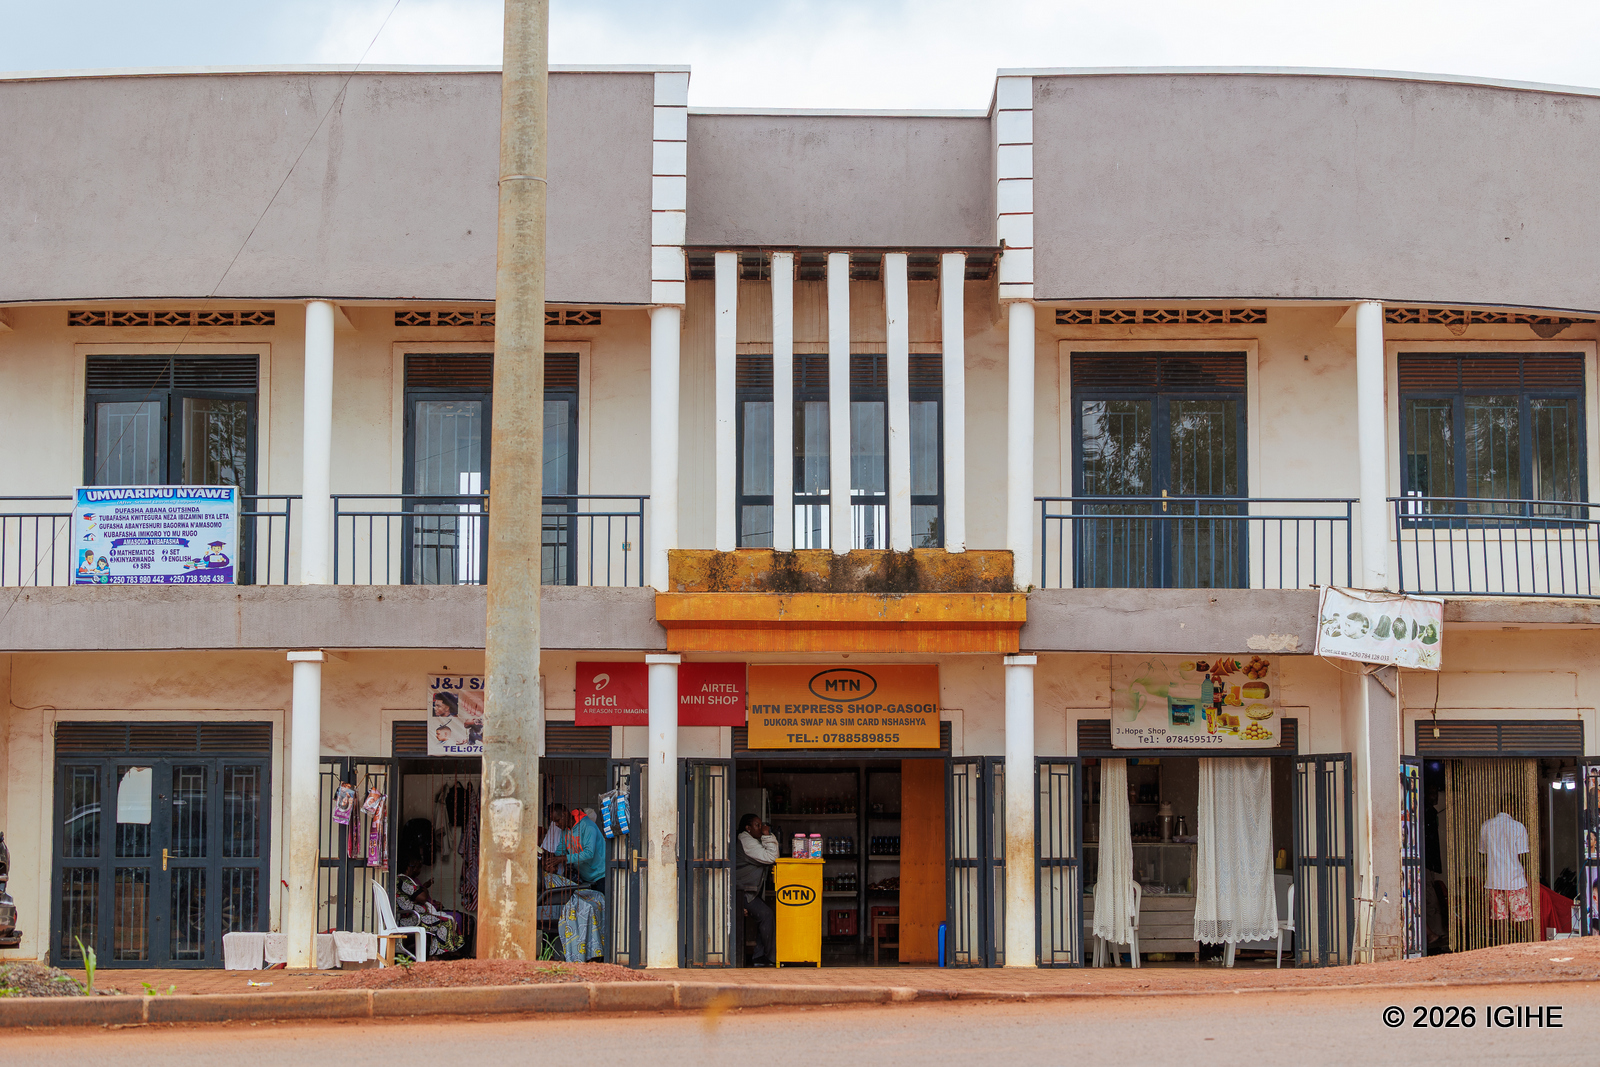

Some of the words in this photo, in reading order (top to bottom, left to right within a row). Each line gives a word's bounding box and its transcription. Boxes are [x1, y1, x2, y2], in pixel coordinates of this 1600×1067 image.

[86, 488, 174, 502] UMWARIMU
[176, 488, 230, 499] NYAWE
[431, 678, 463, 689] J&J
[701, 684, 739, 692] AIRTEL
[825, 679, 860, 691] MTN
[584, 694, 617, 706] airtel
[680, 696, 705, 704] MINI
[708, 696, 738, 705] SHOP
[752, 705, 780, 714] MTN
[785, 704, 843, 714] EXPRESS
[847, 704, 936, 713] SHOP-GASOGI
[787, 734, 818, 742] TEL.:
[822, 734, 900, 742] 0788589855
[782, 890, 810, 900] MTN
